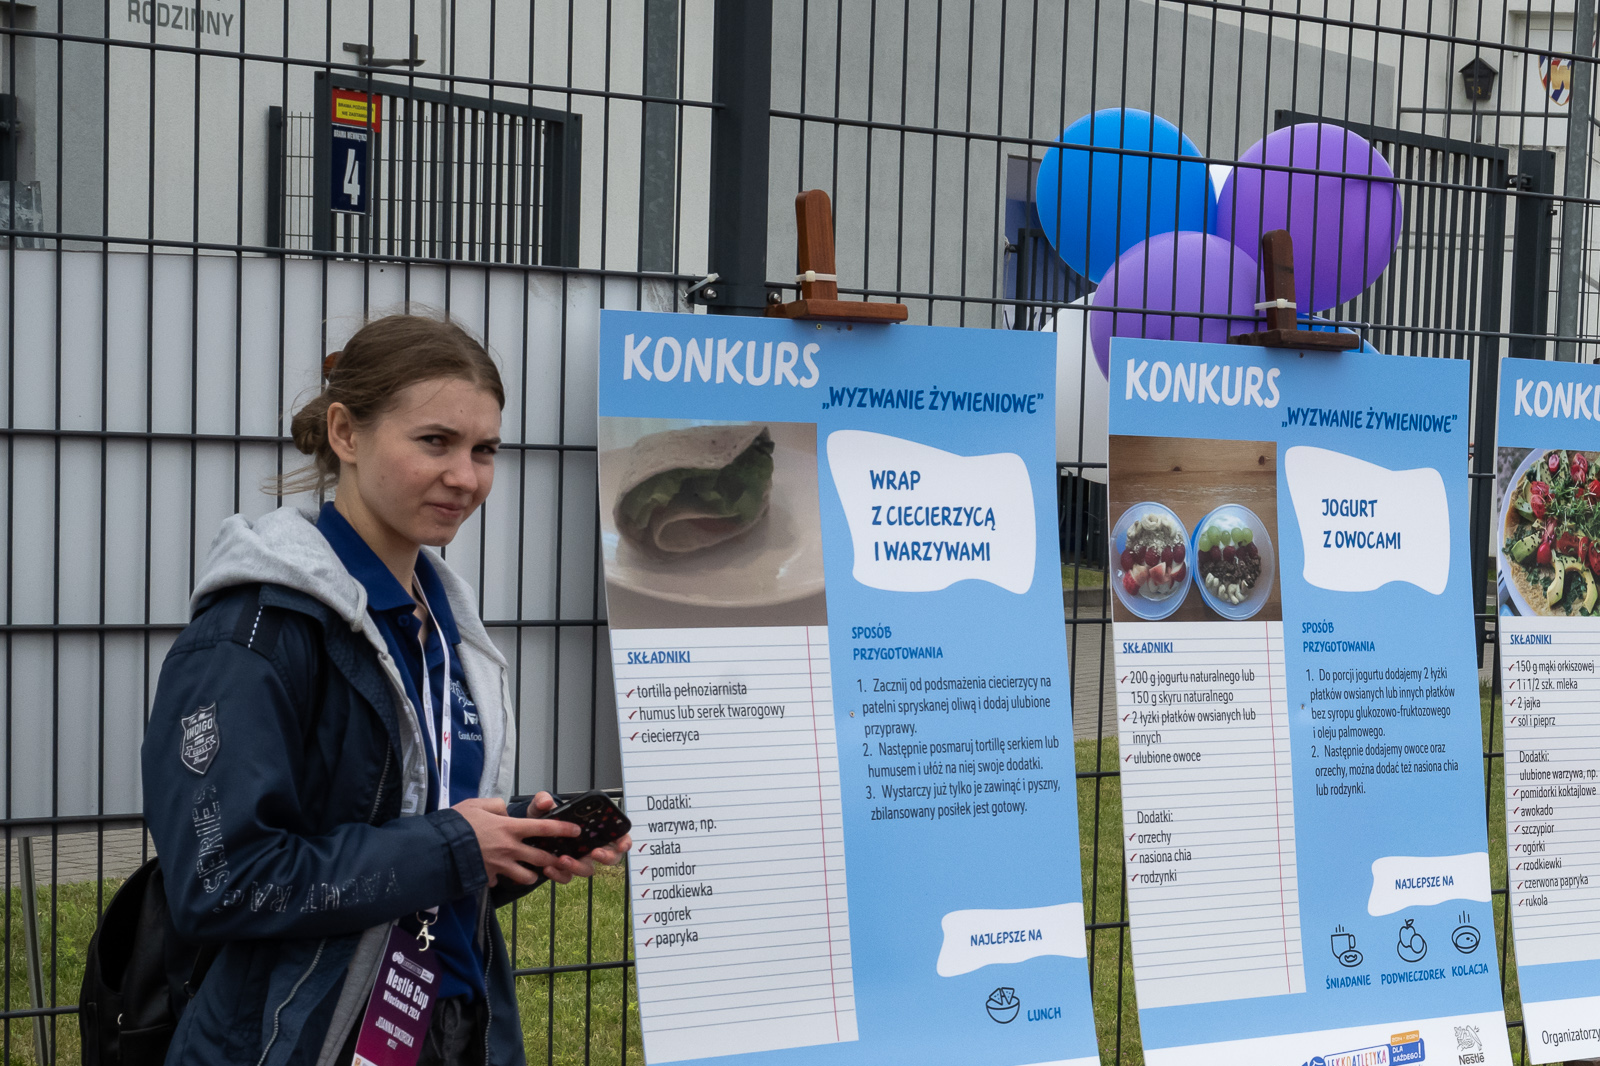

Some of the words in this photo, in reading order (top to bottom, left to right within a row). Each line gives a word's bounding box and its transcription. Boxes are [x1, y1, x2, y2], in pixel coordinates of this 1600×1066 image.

[343, 148, 360, 205] 4
[623, 334, 821, 388] KONKURS
[1126, 358, 1281, 408] KONKURS
[870, 469, 920, 490] WRAP
[1322, 499, 1377, 518] JOGURT
[872, 506, 882, 526] Z
[886, 506, 996, 531] CIECIERZYCĄ
[1323, 531, 1332, 548] Z
[1335, 532, 1401, 550] OWOCAMI
[874, 542, 879, 561] I
[884, 542, 990, 562] WARZYWAMI
[852, 623, 892, 639] SPOSÓB
[1302, 619, 1334, 633] SPOSÓB
[1303, 641, 1375, 652] PRZYGOTOWANIA
[1510, 634, 1552, 644] SKŁADNIKI
[853, 647, 943, 660] PRZYGOTOWANIA
[1123, 642, 1173, 653] SKŁADNIKI
[627, 651, 690, 664] SKŁADNIKI
[857, 679, 866, 693] 1.
[873, 678, 907, 694] Zacznij
[910, 678, 922, 691] od
[925, 676, 986, 693] podsmażenia
[989, 676, 1038, 690] ciecierzycy
[1041, 676, 1051, 687] na
[1130, 671, 1148, 684] 200
[1150, 672, 1156, 686] g
[1158, 671, 1188, 686] jogurtu
[1190, 670, 1240, 686] naturalnego
[1242, 669, 1255, 681] lub
[637, 683, 672, 698] tortilla
[674, 682, 747, 700] pełnoziarnista
[639, 706, 676, 720] humus
[678, 705, 694, 719] lub
[697, 705, 725, 718] serek
[727, 704, 785, 719] twarogowy
[187, 718, 212, 740] INDIGO
[641, 729, 700, 745] ciecierzyca
[1134, 751, 1171, 764] ulubione
[1173, 751, 1201, 761] owoce
[647, 794, 692, 810] Dodatki:
[1521, 804, 1553, 816] awokado
[1137, 810, 1173, 823] Dodatki:
[648, 819, 698, 834] warzywa,
[700, 818, 717, 832] np.
[1522, 823, 1554, 837] szczypior
[1138, 830, 1171, 845] orzechy
[650, 841, 681, 855] sałata
[1140, 851, 1172, 863] nasiona
[1174, 849, 1192, 861] chia
[651, 862, 696, 881] pomidor
[1140, 869, 1177, 885] rodzynki
[653, 883, 713, 900] rzodkiewka
[1526, 895, 1548, 907] rukola
[654, 907, 691, 925] ogórek
[656, 929, 698, 948] papryka
[970, 930, 1026, 947] NAJLEPSZE
[1028, 929, 1042, 942] NA
[1326, 974, 1371, 989] ŚNIADANIE
[1381, 968, 1446, 985] PODWIECZOREK
[1452, 963, 1489, 977] KOLACJA
[386, 968, 414, 997] Nestlé
[413, 985, 429, 1009] Cup
[408, 1006, 420, 1021] 2024
[1027, 1006, 1061, 1022] LUNCH
[1542, 1026, 1600, 1045] Organizatorzy
